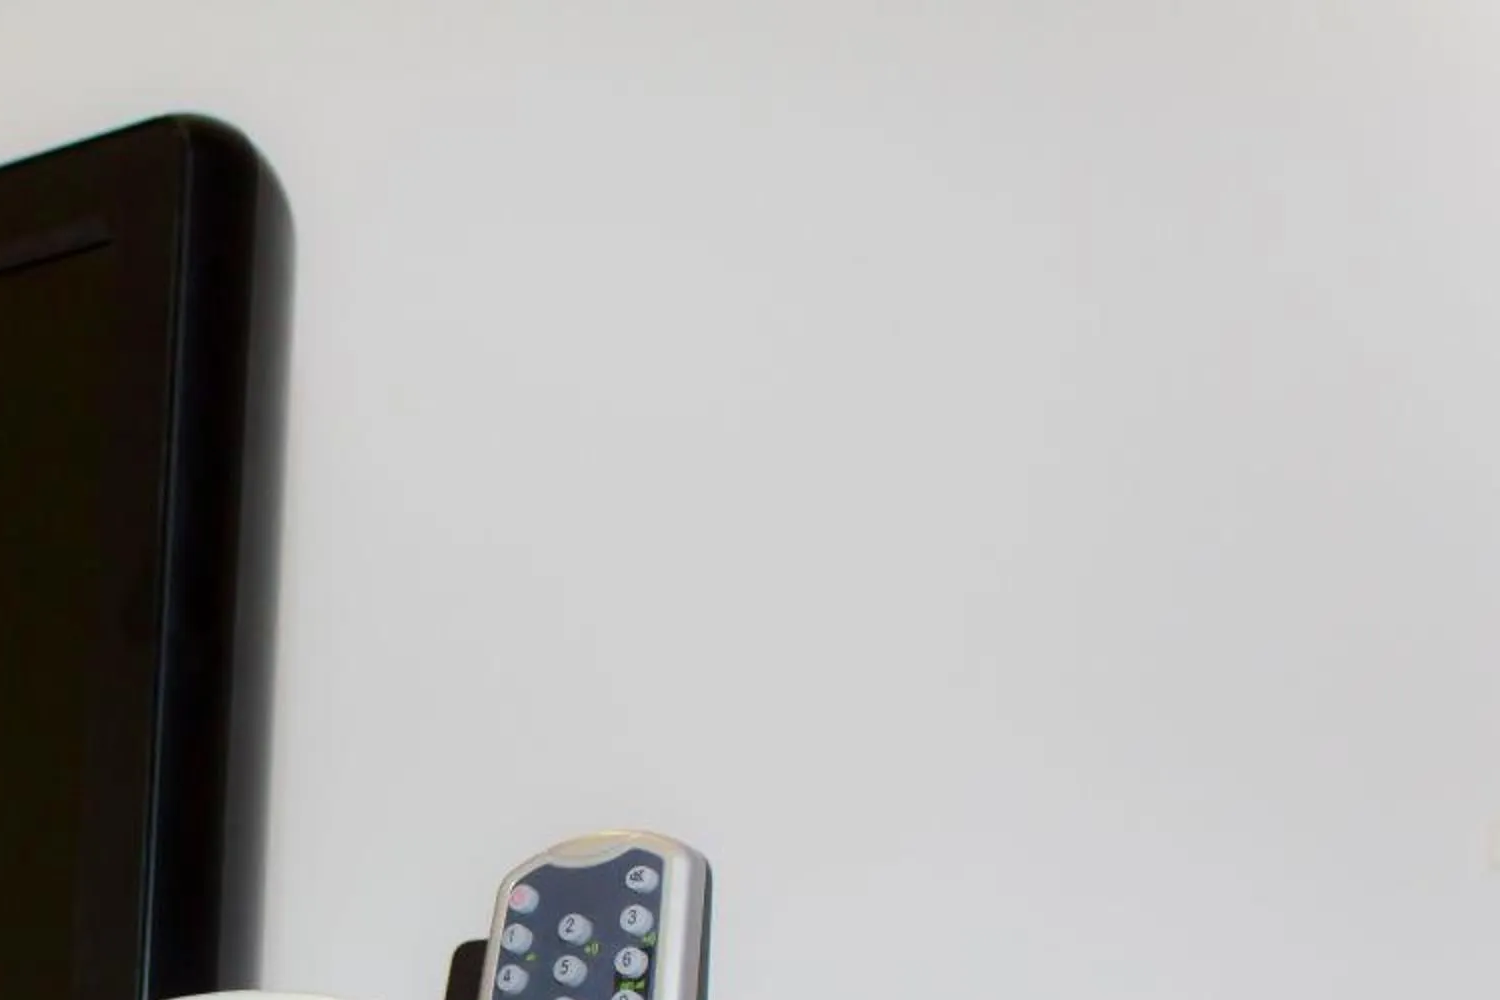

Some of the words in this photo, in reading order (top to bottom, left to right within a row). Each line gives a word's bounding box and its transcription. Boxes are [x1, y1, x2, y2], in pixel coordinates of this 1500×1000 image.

[627, 909, 638, 925] 3
[565, 917, 576, 934] 2
[560, 959, 570, 975] 5
[622, 950, 632, 968] 6
